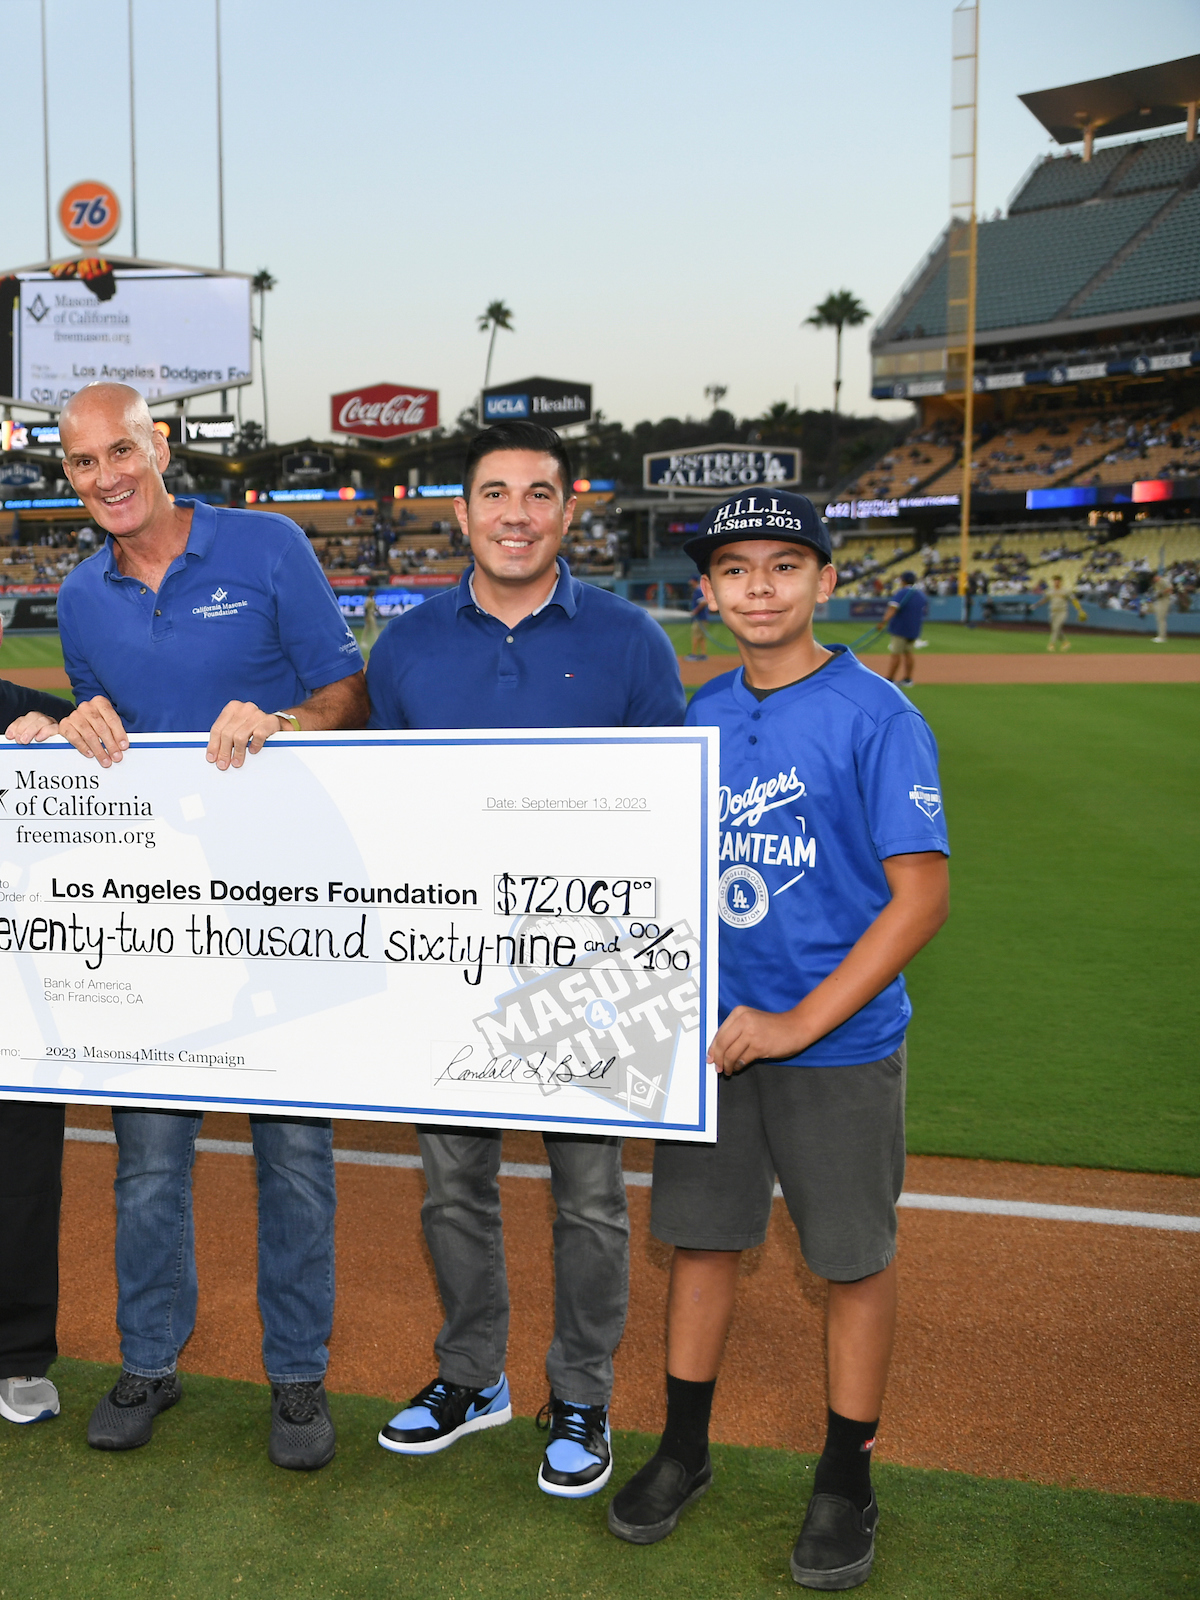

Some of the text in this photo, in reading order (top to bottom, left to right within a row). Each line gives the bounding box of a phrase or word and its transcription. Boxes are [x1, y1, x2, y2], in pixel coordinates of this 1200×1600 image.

[71, 197, 107, 227] 76
[54, 311, 130, 324] of California
[54, 330, 130, 343] freemason.org
[72, 365, 96, 377] Los
[100, 365, 154, 380] Angeles
[160, 366, 222, 382] Dodgers
[488, 395, 585, 413] UCLA Health
[658, 467, 758, 486] JALISCO
[713, 497, 792, 523] H.I.L.L.
[706, 515, 802, 535] All-Stars 2023
[192, 600, 248, 615] California Masonic
[204, 608, 238, 619] Foundation
[15, 770, 99, 790] Masons
[15, 796, 38, 816] of
[43, 795, 153, 817] California
[487, 797, 647, 811] Date: September 13, 2023
[719, 766, 805, 827] Dodgers
[16, 825, 156, 849] freemason.org
[719, 831, 816, 868] AMTEAM
[0, 879, 10, 889] to
[28, 892, 42, 903] of:
[51, 878, 95, 899] Los
[102, 878, 201, 905] Angeles
[210, 880, 320, 907] Dodgers
[328, 881, 478, 905] Foundation
[733, 884, 747, 909] LA
[722, 906, 760, 923] FOUNDATION
[185, 913, 369, 959] thousand
[384, 921, 577, 986] sixty-nine
[584, 935, 621, 953] and
[44, 978, 132, 991] Bank of America
[44, 991, 144, 1005] San Francisco, CA
[591, 1000, 611, 1026] 4
[46, 1047, 76, 1059] 2023
[83, 1046, 175, 1063] Masons4Mitts
[178, 1049, 246, 1067] Campaign
